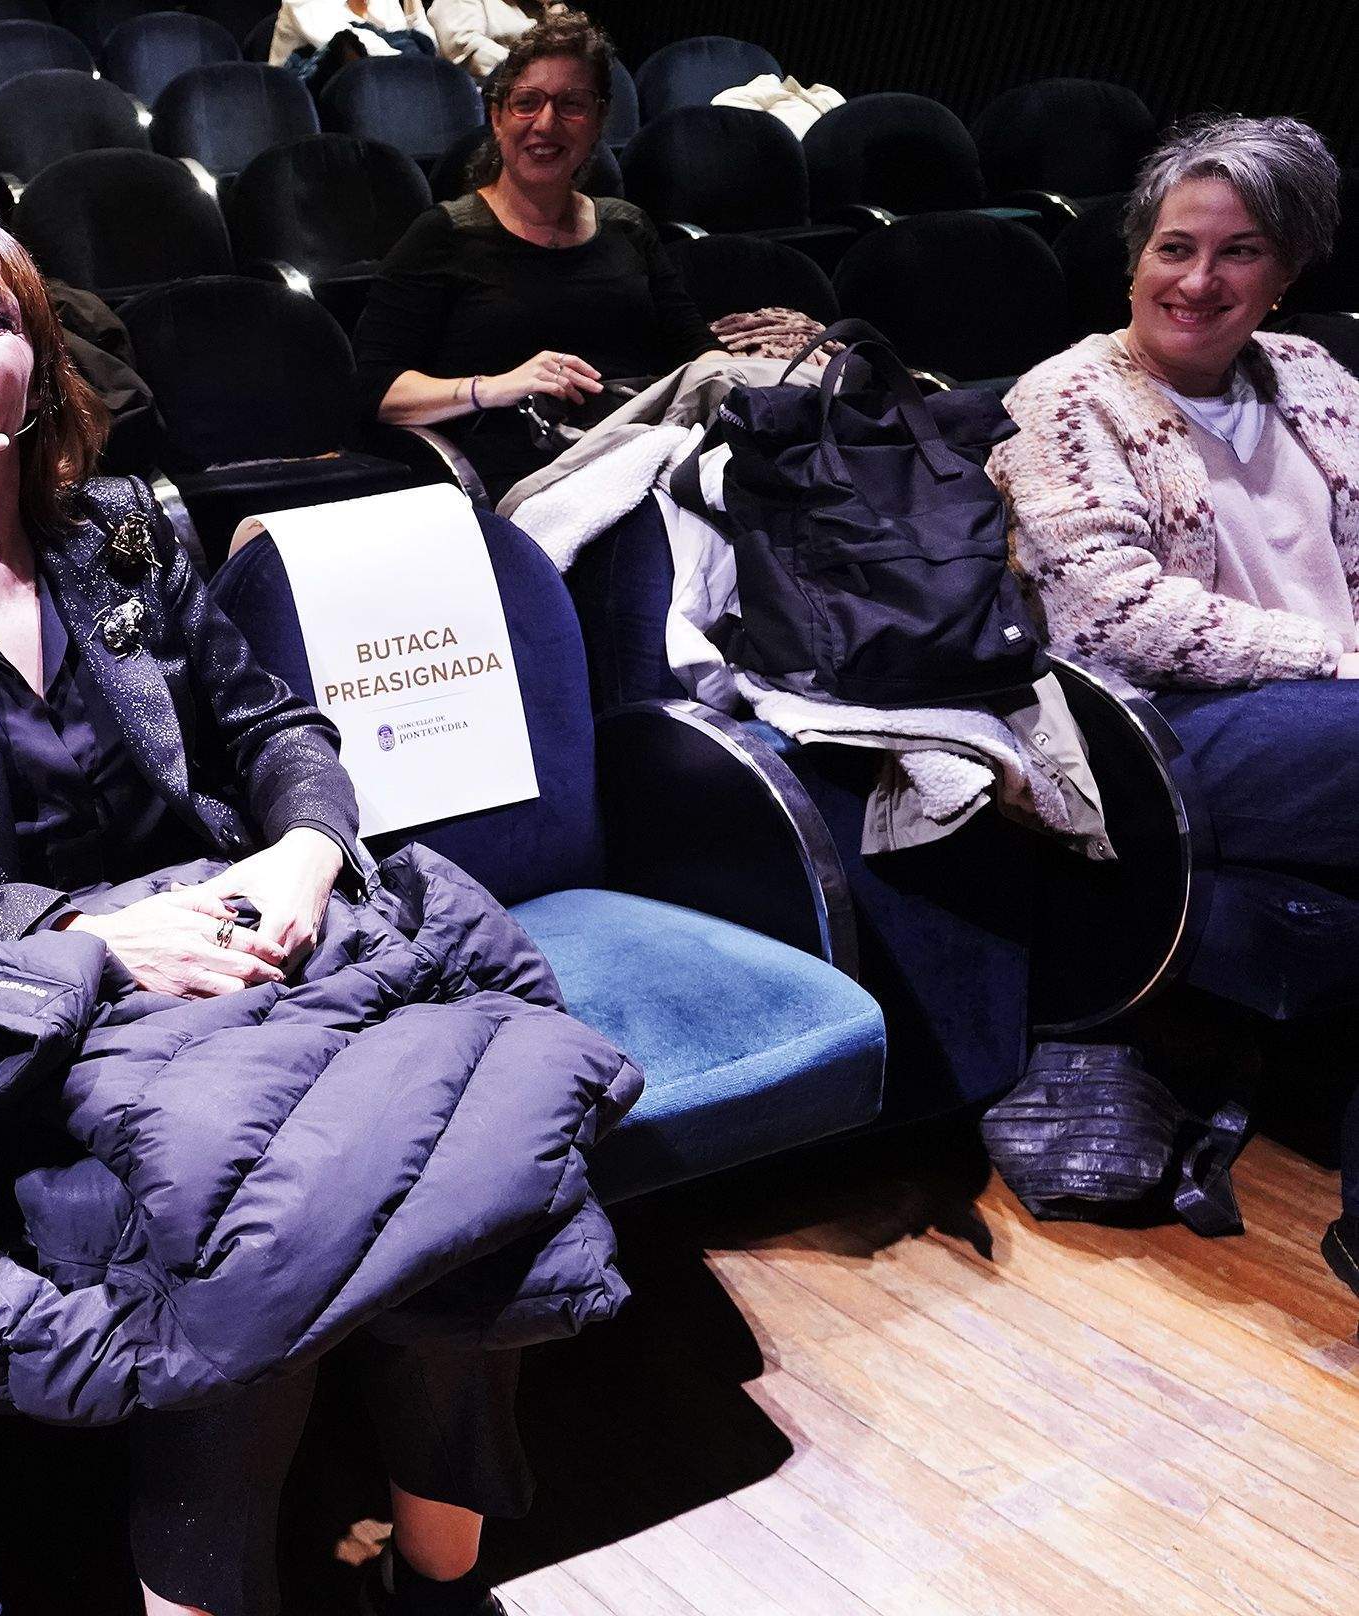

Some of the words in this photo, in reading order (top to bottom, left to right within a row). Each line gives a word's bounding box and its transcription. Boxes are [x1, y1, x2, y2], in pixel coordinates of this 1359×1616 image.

[356, 627, 458, 663] BUTACA
[325, 652, 503, 705] PREASIGNADA
[396, 717, 434, 732] CONCELLO
[435, 715, 446, 723] DE
[399, 721, 469, 744] PONTEVEDRA
